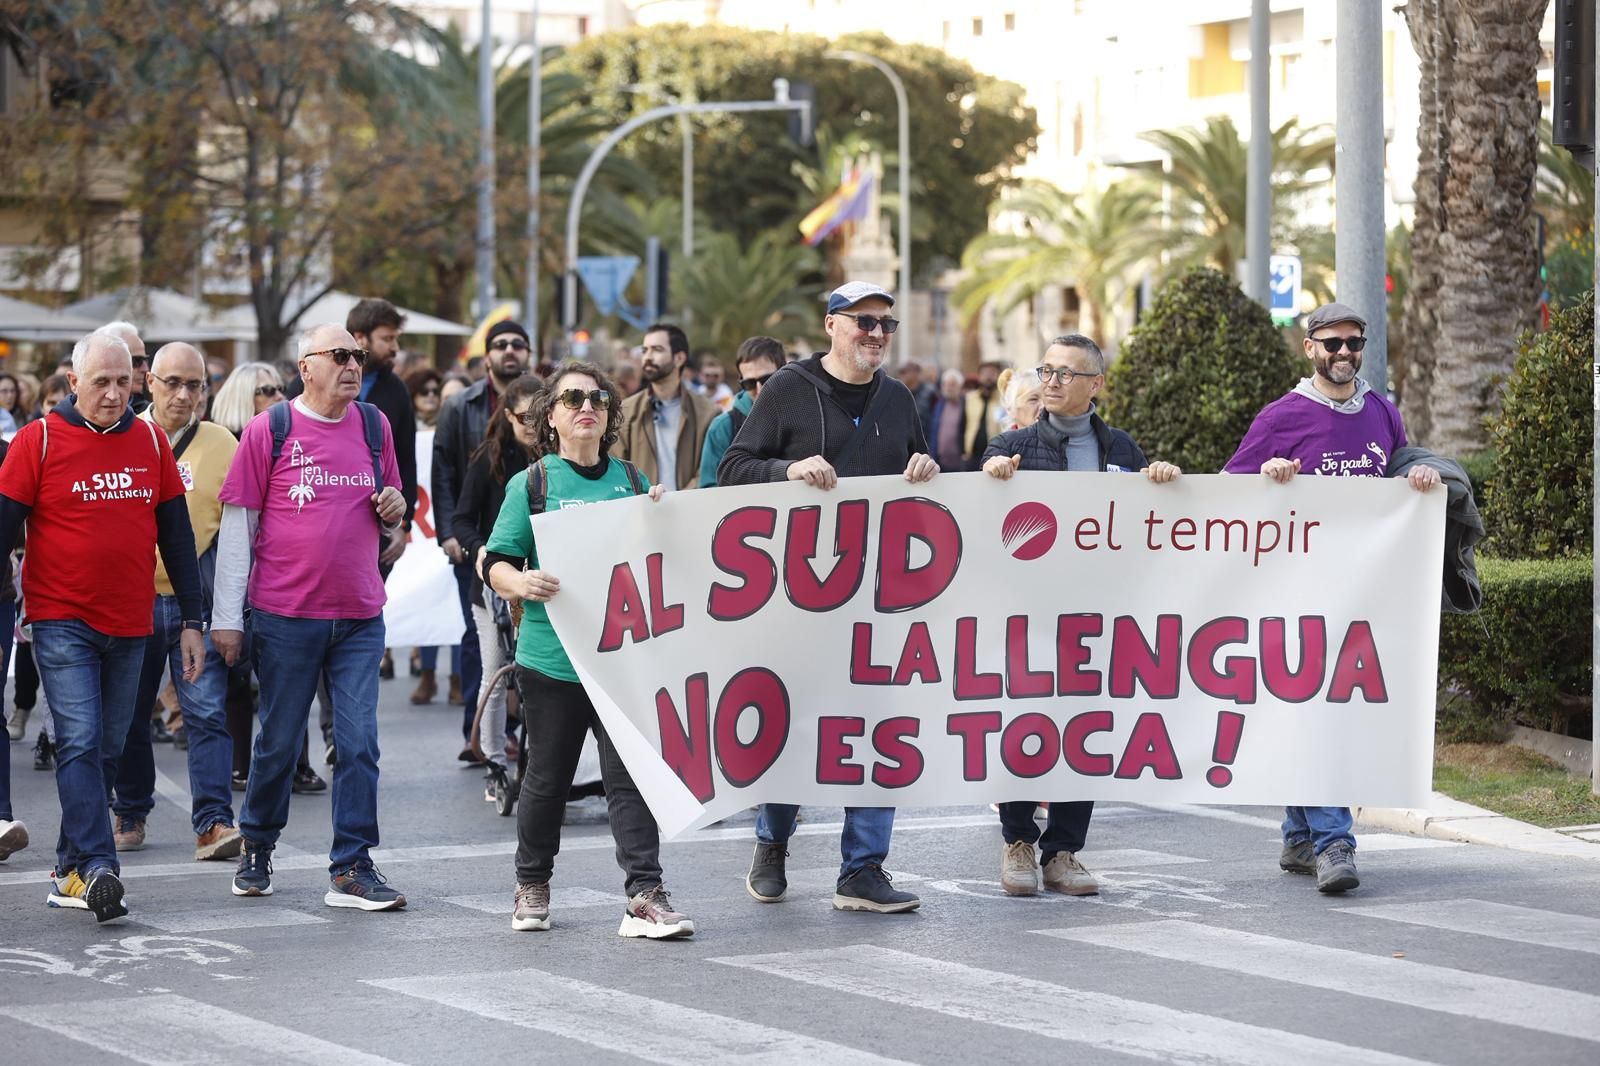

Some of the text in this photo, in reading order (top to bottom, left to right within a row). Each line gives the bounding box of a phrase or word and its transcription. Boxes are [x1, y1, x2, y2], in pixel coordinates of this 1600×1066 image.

[292, 440, 303, 453] A
[304, 466, 321, 475] en
[1322, 454, 1373, 472] Jo parle
[72, 473, 132, 492] AL SUD
[83, 492, 97, 501] EN
[1074, 500, 1321, 567] el tempir
[597, 496, 963, 653] AL SUD
[849, 612, 1389, 704] LA LLENGUA
[655, 666, 791, 804] NO
[815, 715, 925, 789] ES
